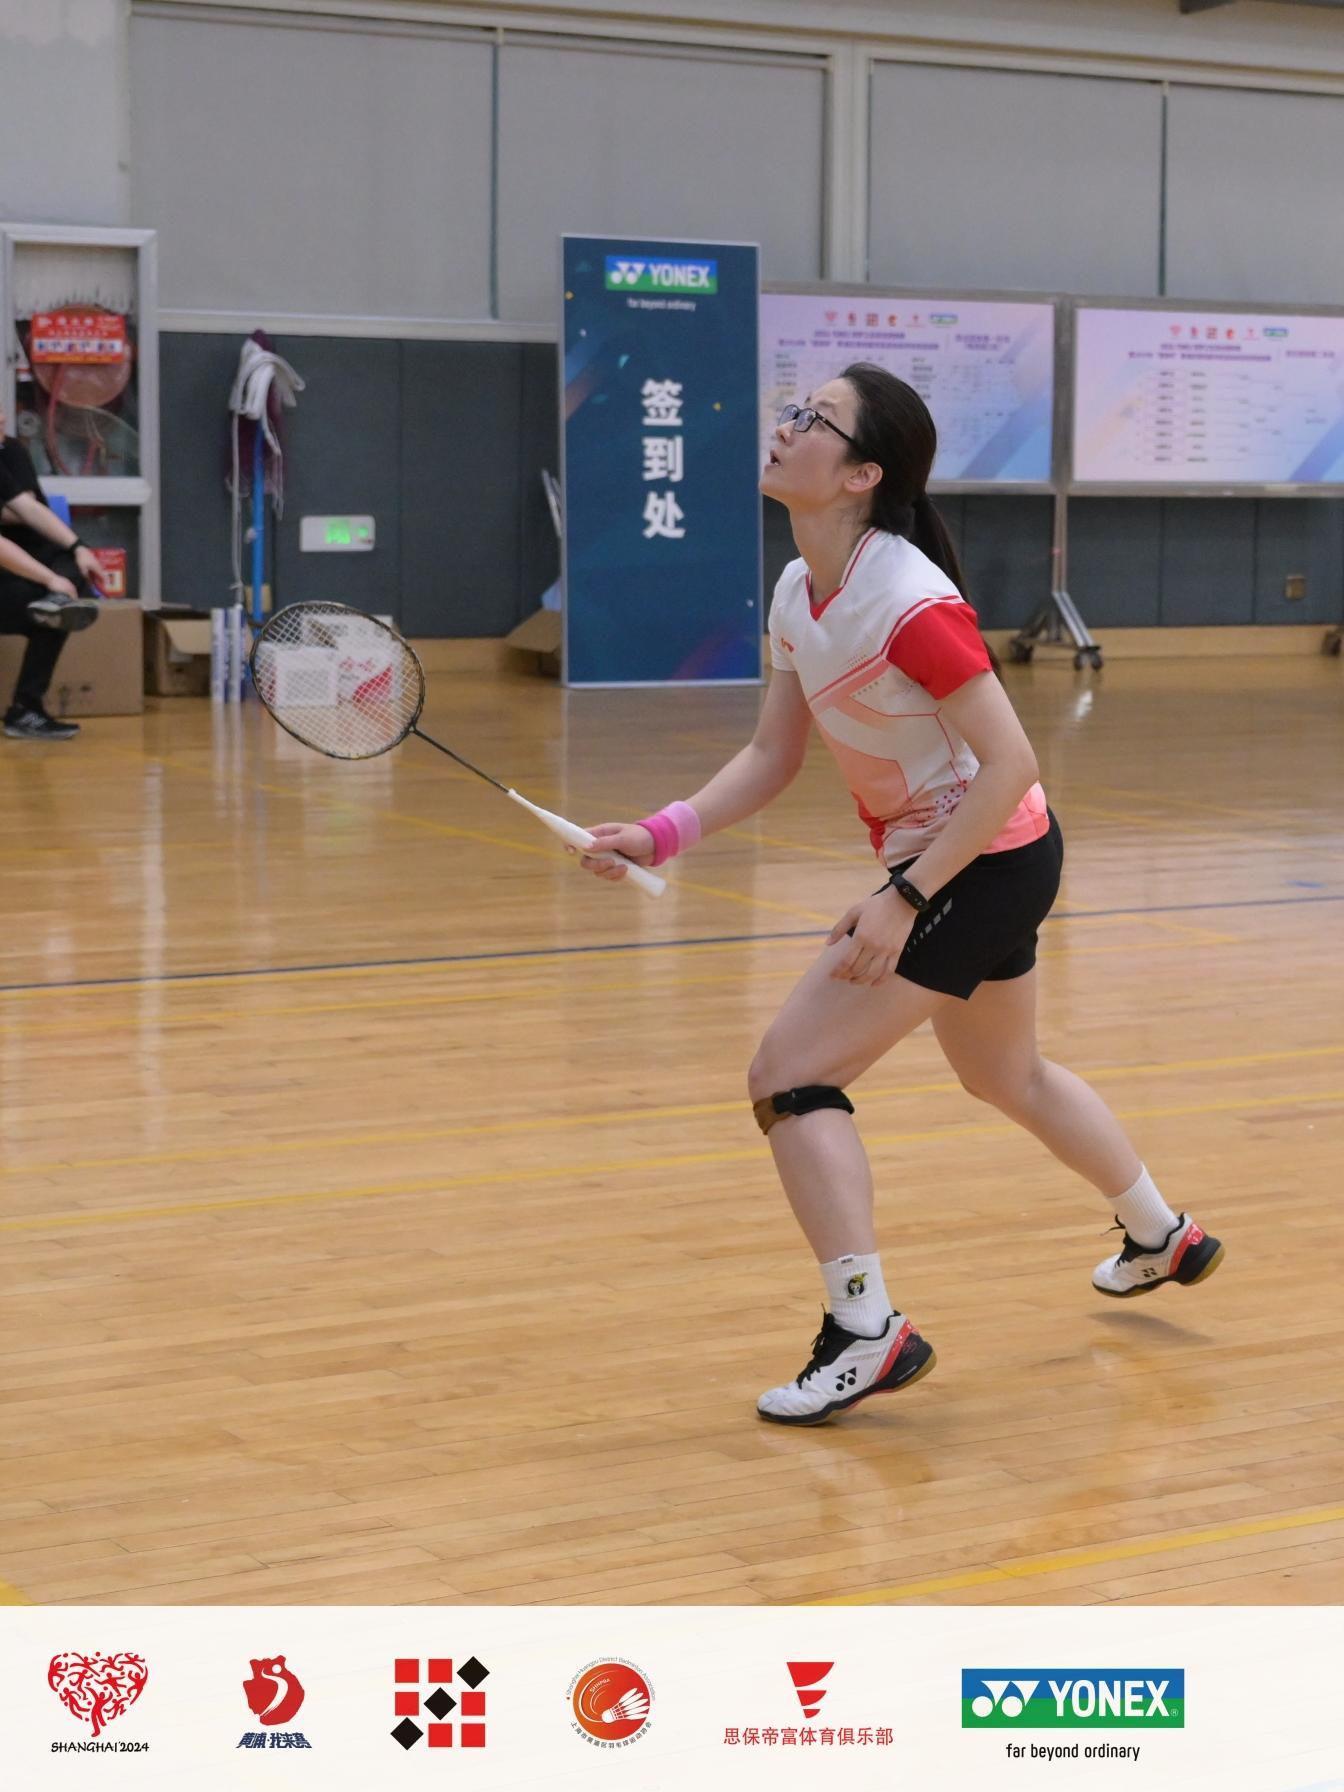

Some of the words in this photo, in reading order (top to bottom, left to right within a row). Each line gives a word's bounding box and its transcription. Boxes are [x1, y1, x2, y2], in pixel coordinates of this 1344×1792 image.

[648, 263, 710, 288] YONEX
[641, 378, 686, 539] 签到处
